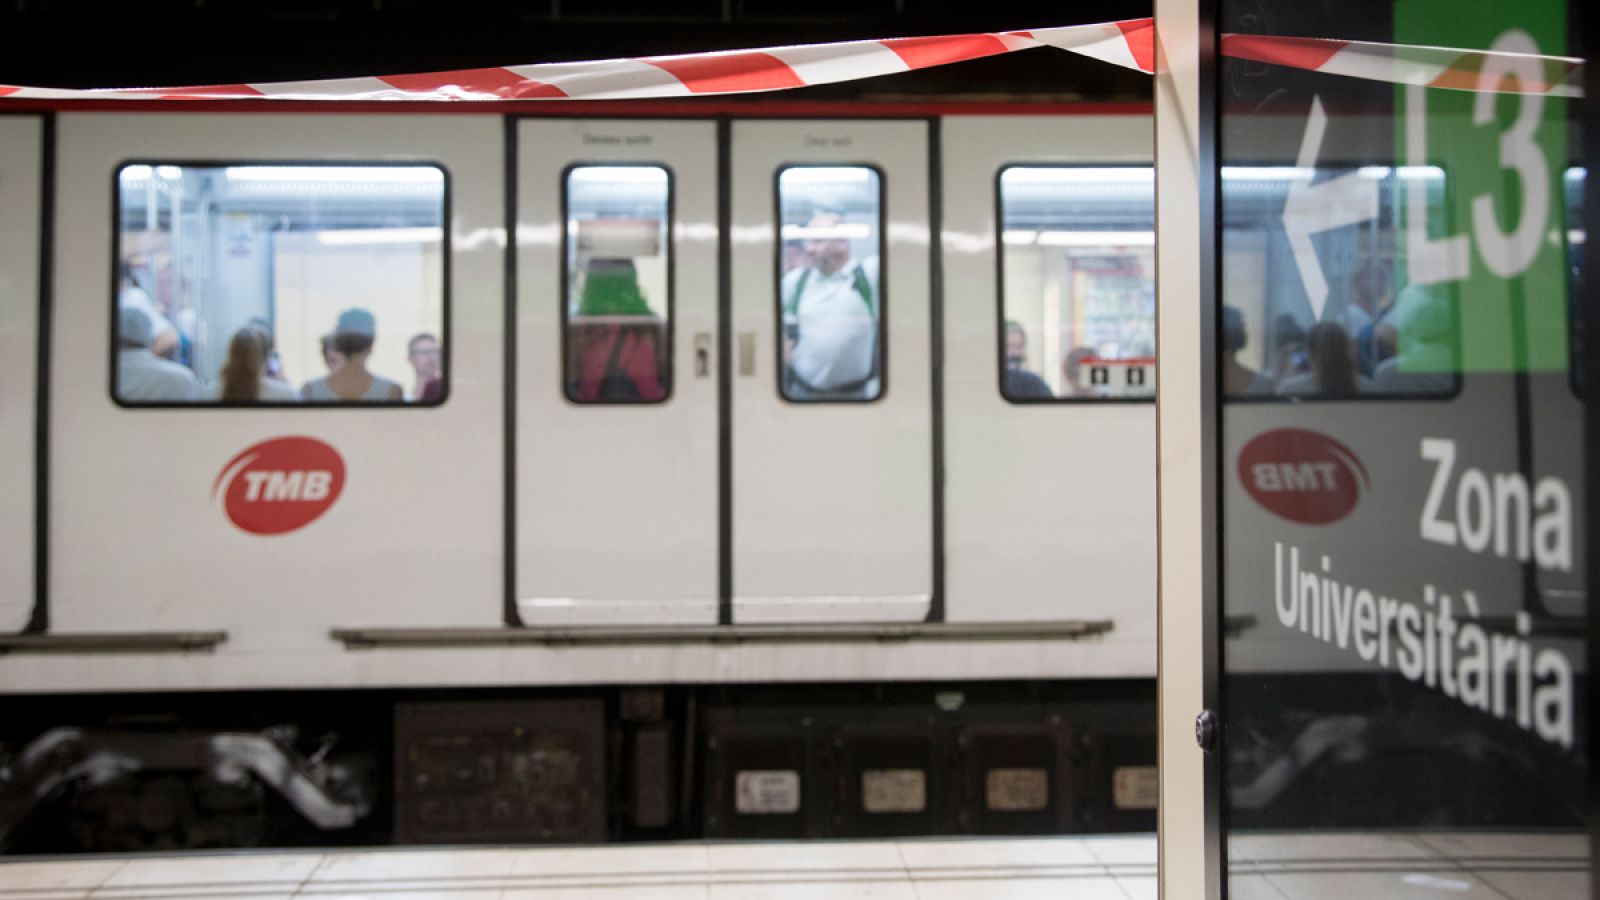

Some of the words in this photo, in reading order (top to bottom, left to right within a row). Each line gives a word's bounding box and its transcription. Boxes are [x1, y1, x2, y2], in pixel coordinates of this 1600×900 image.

[1404, 28, 1549, 285] L3
[244, 470, 332, 502] TMB
[1420, 437, 1572, 572] Zona
[1274, 541, 1574, 749] Universitària
